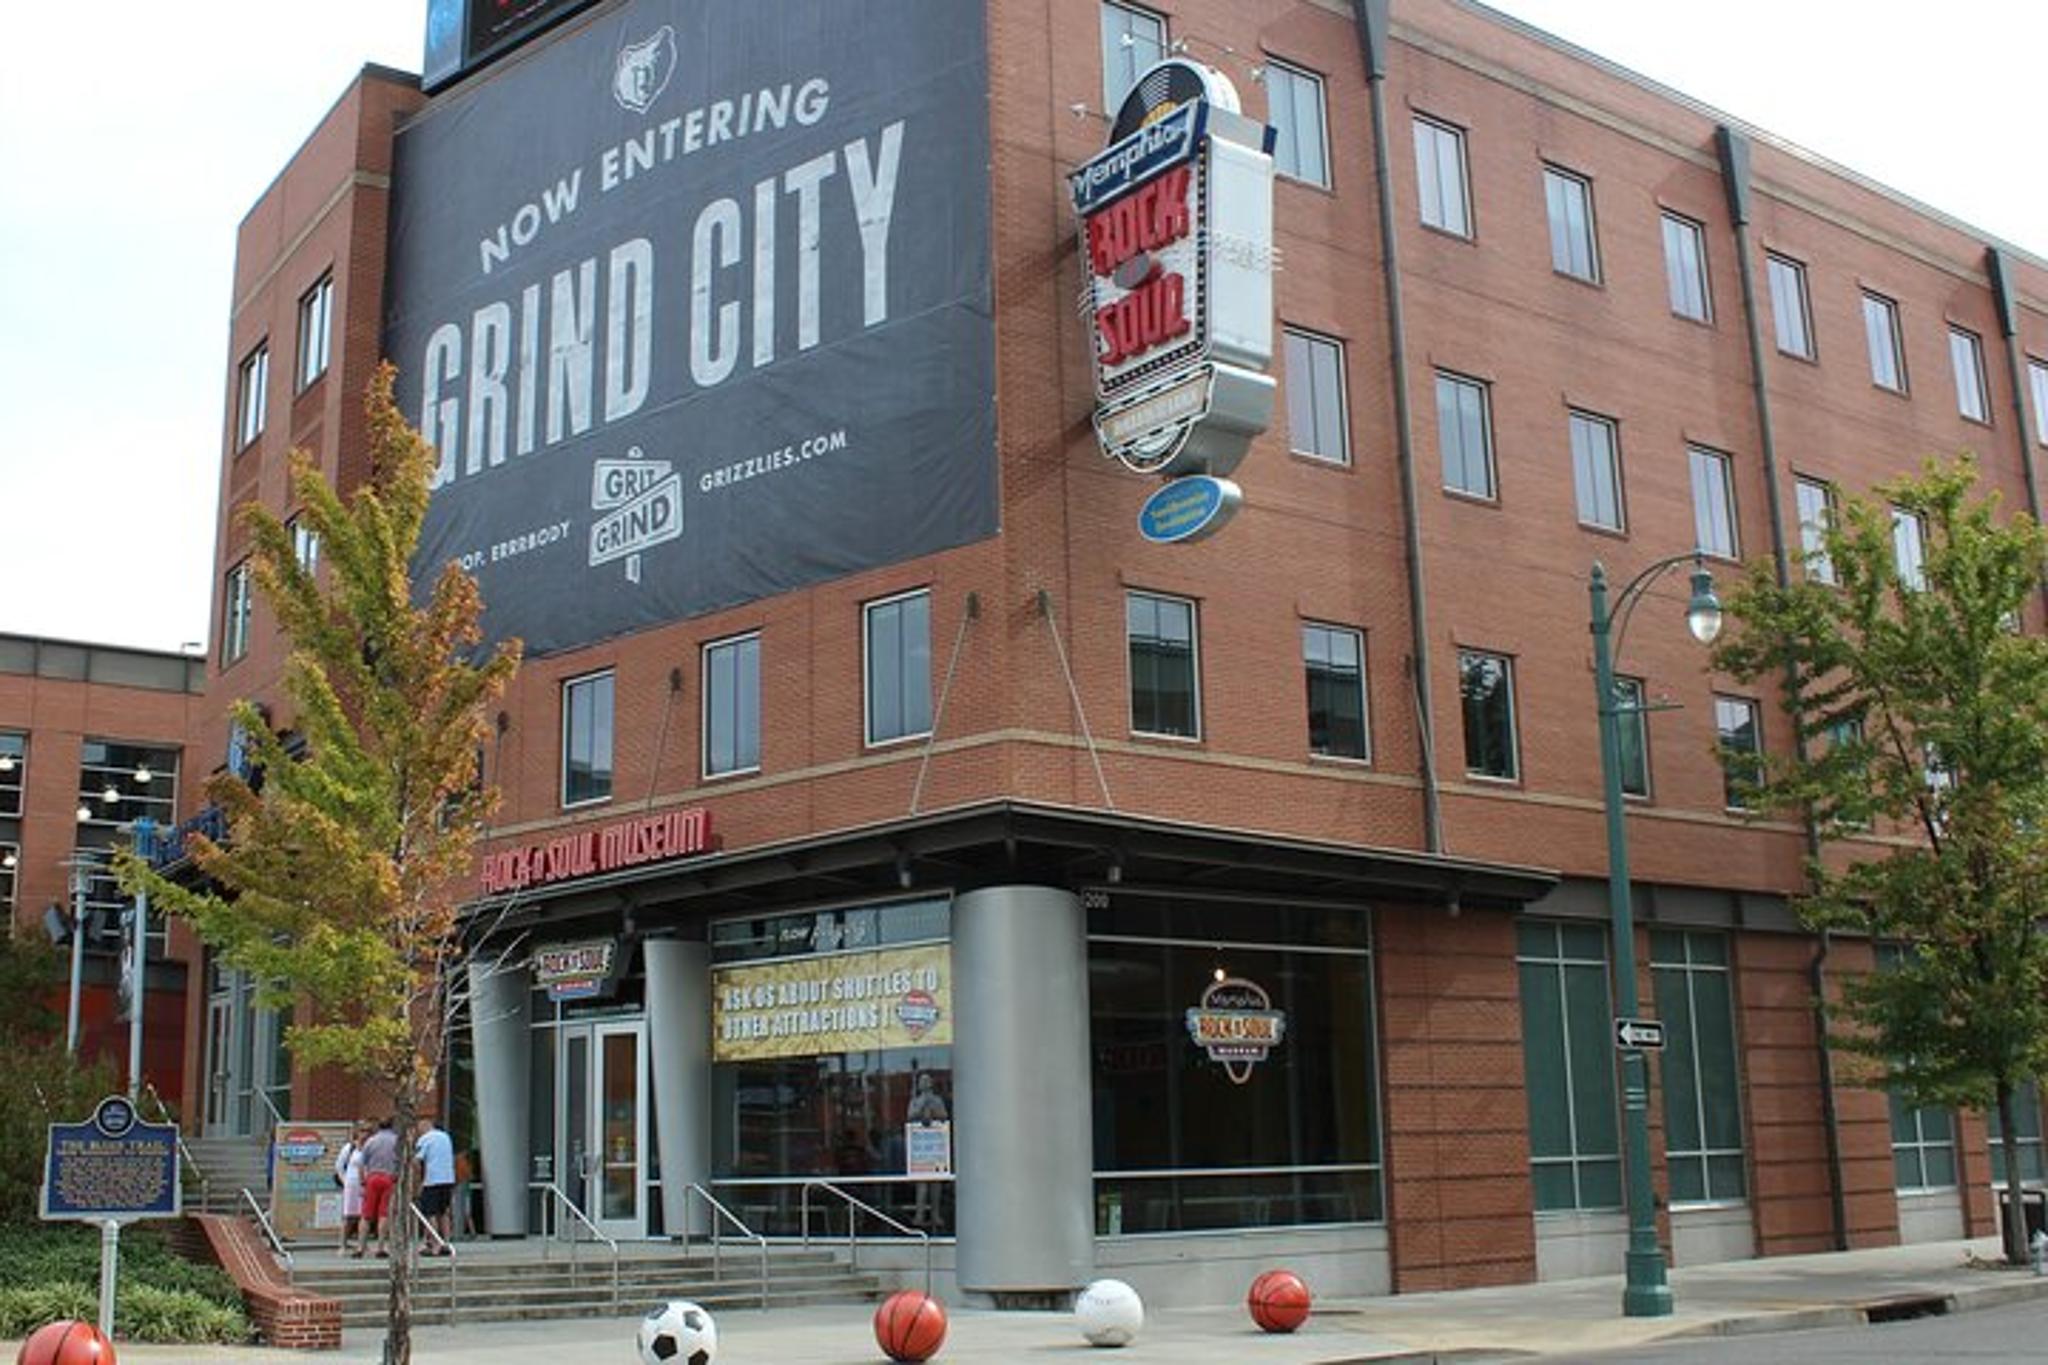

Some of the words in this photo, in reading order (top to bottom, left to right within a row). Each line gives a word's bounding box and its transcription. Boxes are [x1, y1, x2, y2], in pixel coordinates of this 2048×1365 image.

[479, 168, 582, 275] NOW
[601, 76, 832, 193] ENTERING
[1087, 165, 1191, 278] ROCK
[419, 236, 656, 492] GRIND
[689, 119, 906, 389] CITY
[1095, 270, 1192, 367] SOUL
[605, 467, 656, 500] GRIT
[700, 430, 848, 493] GRIZZLIES.COM
[596, 493, 671, 554] GRIND
[481, 847, 531, 893] ROCK
[546, 833, 595, 881] SOUL
[601, 809, 709, 870] MUSEUM
[724, 987, 752, 1011] ASK
[779, 980, 829, 1006] ABOUT
[832, 970, 912, 999] SHUTTLES
[915, 966, 937, 990] TO
[724, 1014, 769, 1041] OTHER
[773, 1003, 878, 1037] ATTRACTIONS
